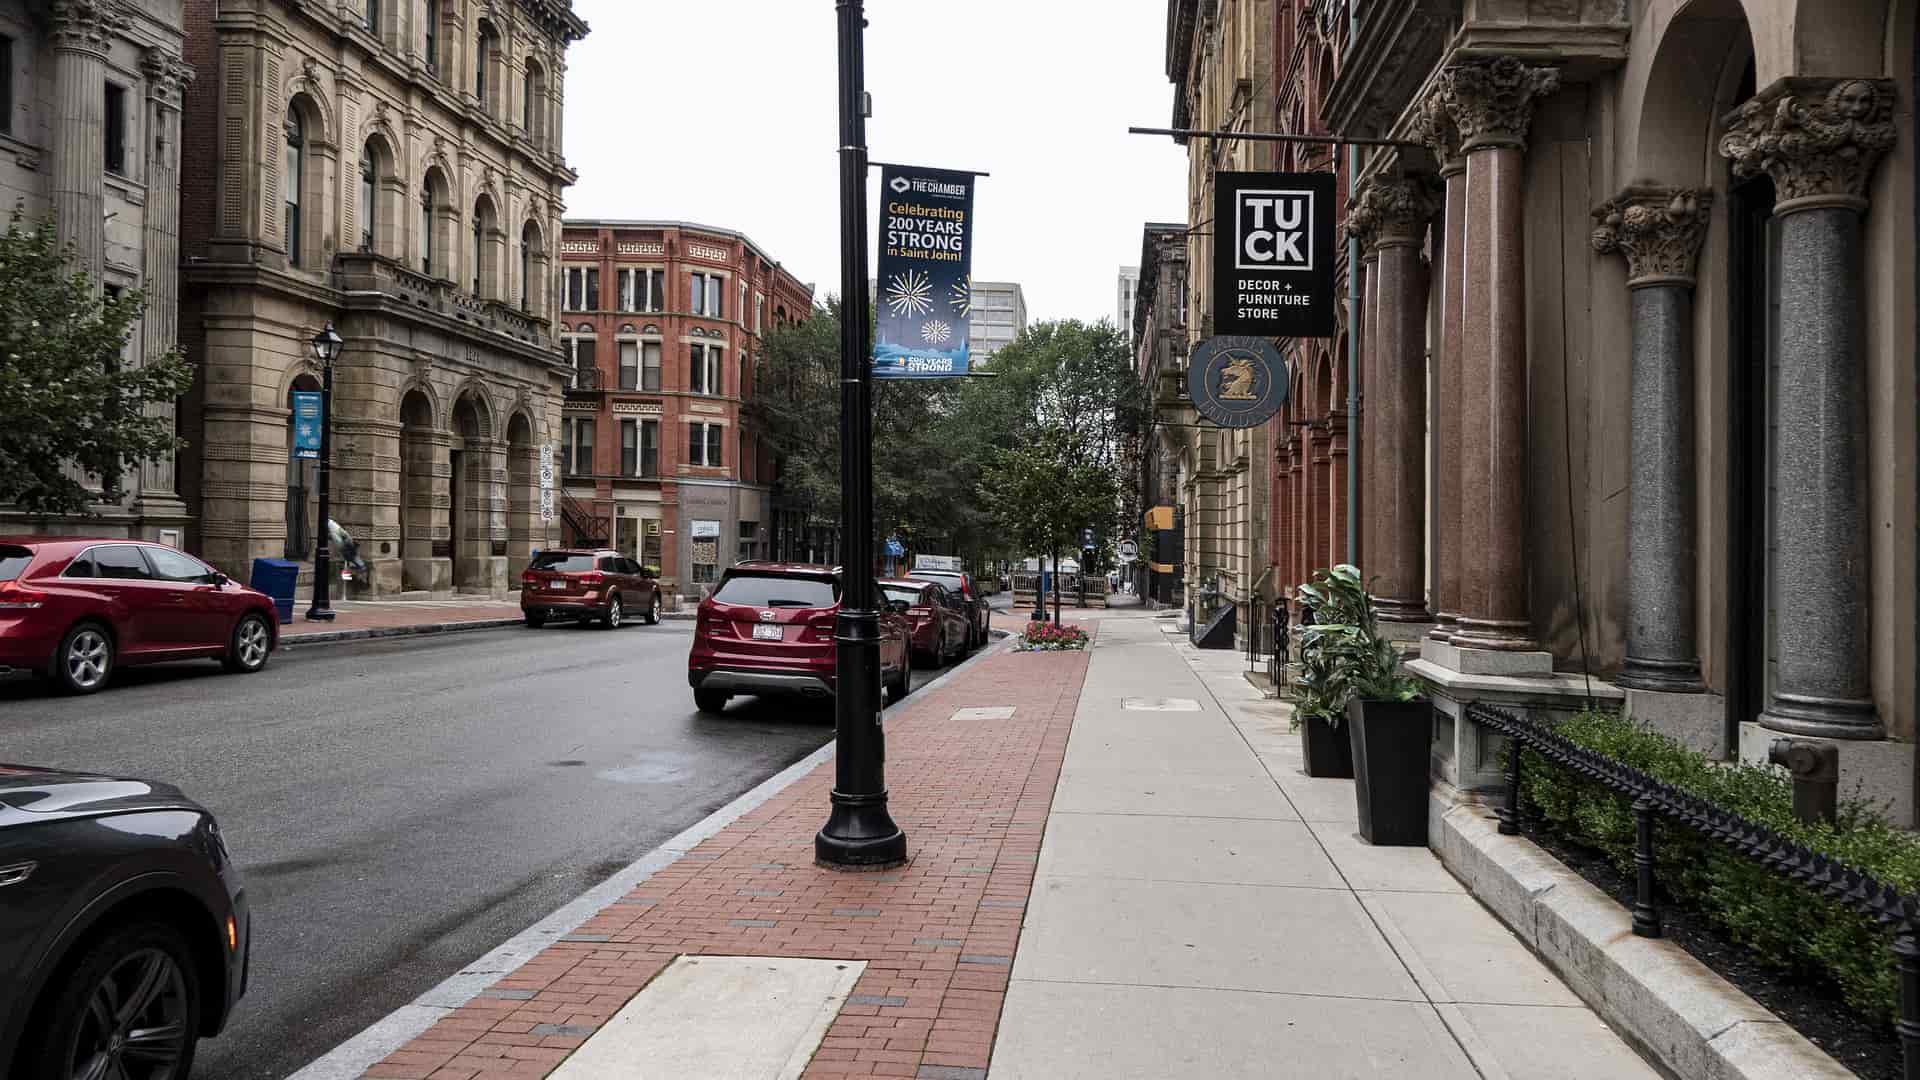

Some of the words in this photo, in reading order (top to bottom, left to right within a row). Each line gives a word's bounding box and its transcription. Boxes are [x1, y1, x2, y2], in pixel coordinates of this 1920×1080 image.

[912, 181, 928, 192] THE
[928, 183, 966, 195] CHAMBER
[888, 202, 964, 222] Celebrating
[888, 216, 914, 231] 200
[916, 219, 964, 235] YEARS
[887, 230, 963, 251] STRONG
[887, 246, 897, 256] in
[900, 247, 930, 259] Saint
[930, 249, 962, 261] John!
[1238, 279, 1280, 290] DECOR
[1284, 283, 1293, 291] +
[1238, 294, 1310, 305] FURNITURE
[1238, 308, 1279, 319] STORE
[908, 362, 953, 371] STRONG
[926, 357, 953, 365] YEARS
